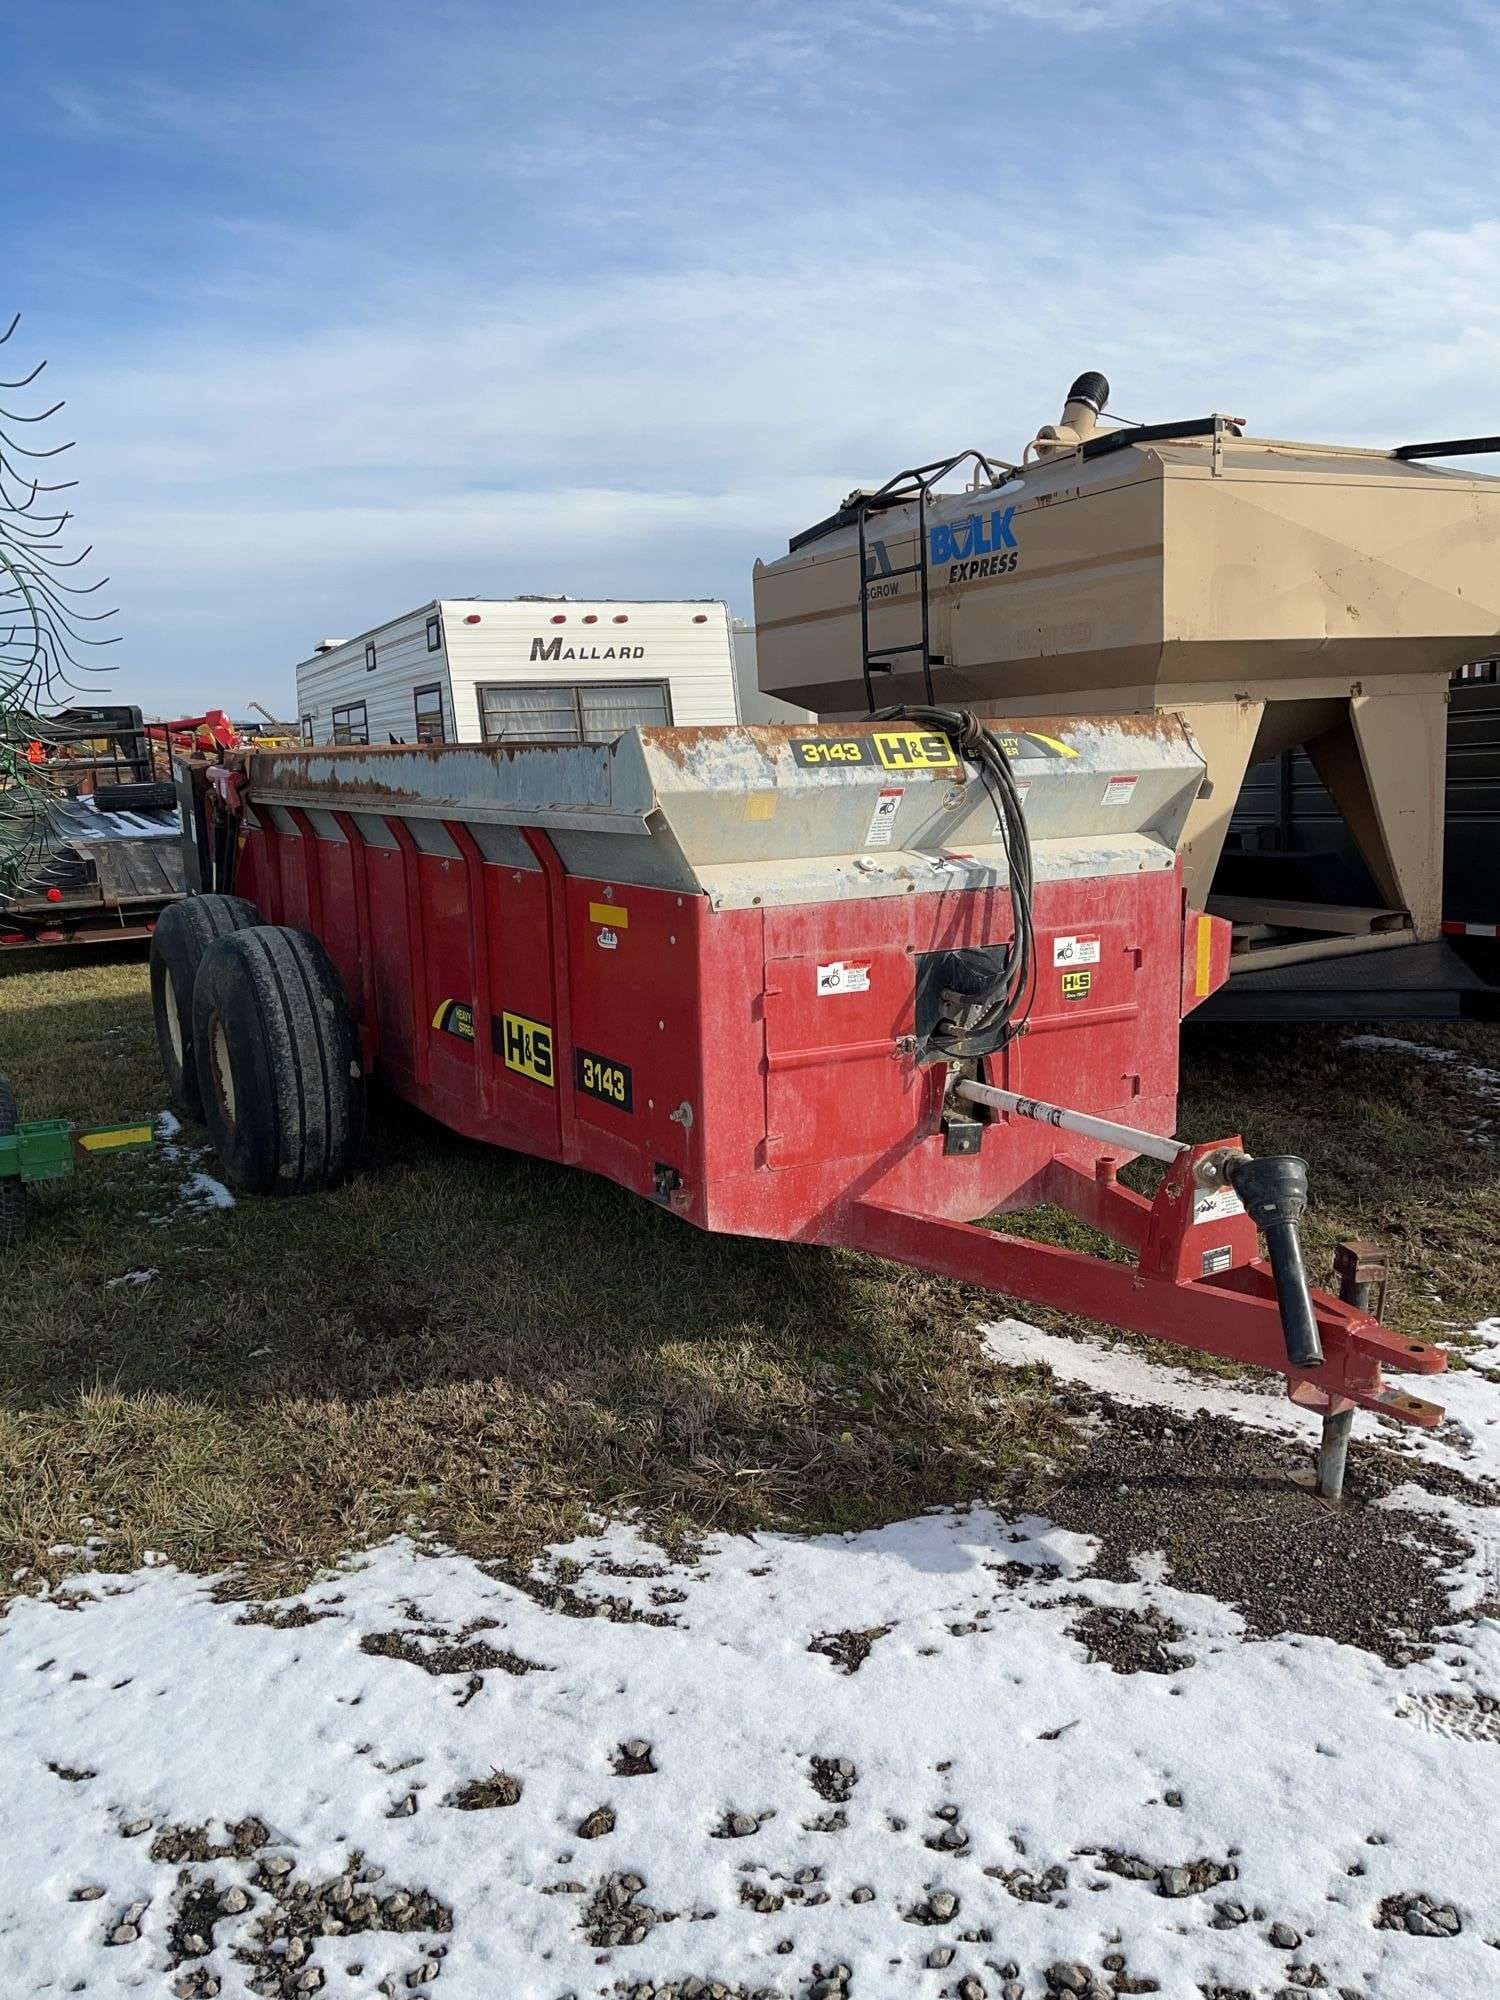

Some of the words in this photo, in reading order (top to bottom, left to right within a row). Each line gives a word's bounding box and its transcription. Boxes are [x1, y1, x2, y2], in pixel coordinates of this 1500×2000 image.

[930, 506, 1018, 566] BULK
[949, 552, 1019, 584] EXPRESS
[801, 743, 862, 762] 3143
[879, 736, 951, 763] H&S
[506, 1020, 552, 1077] H&S
[583, 1058, 625, 1102] 3143
